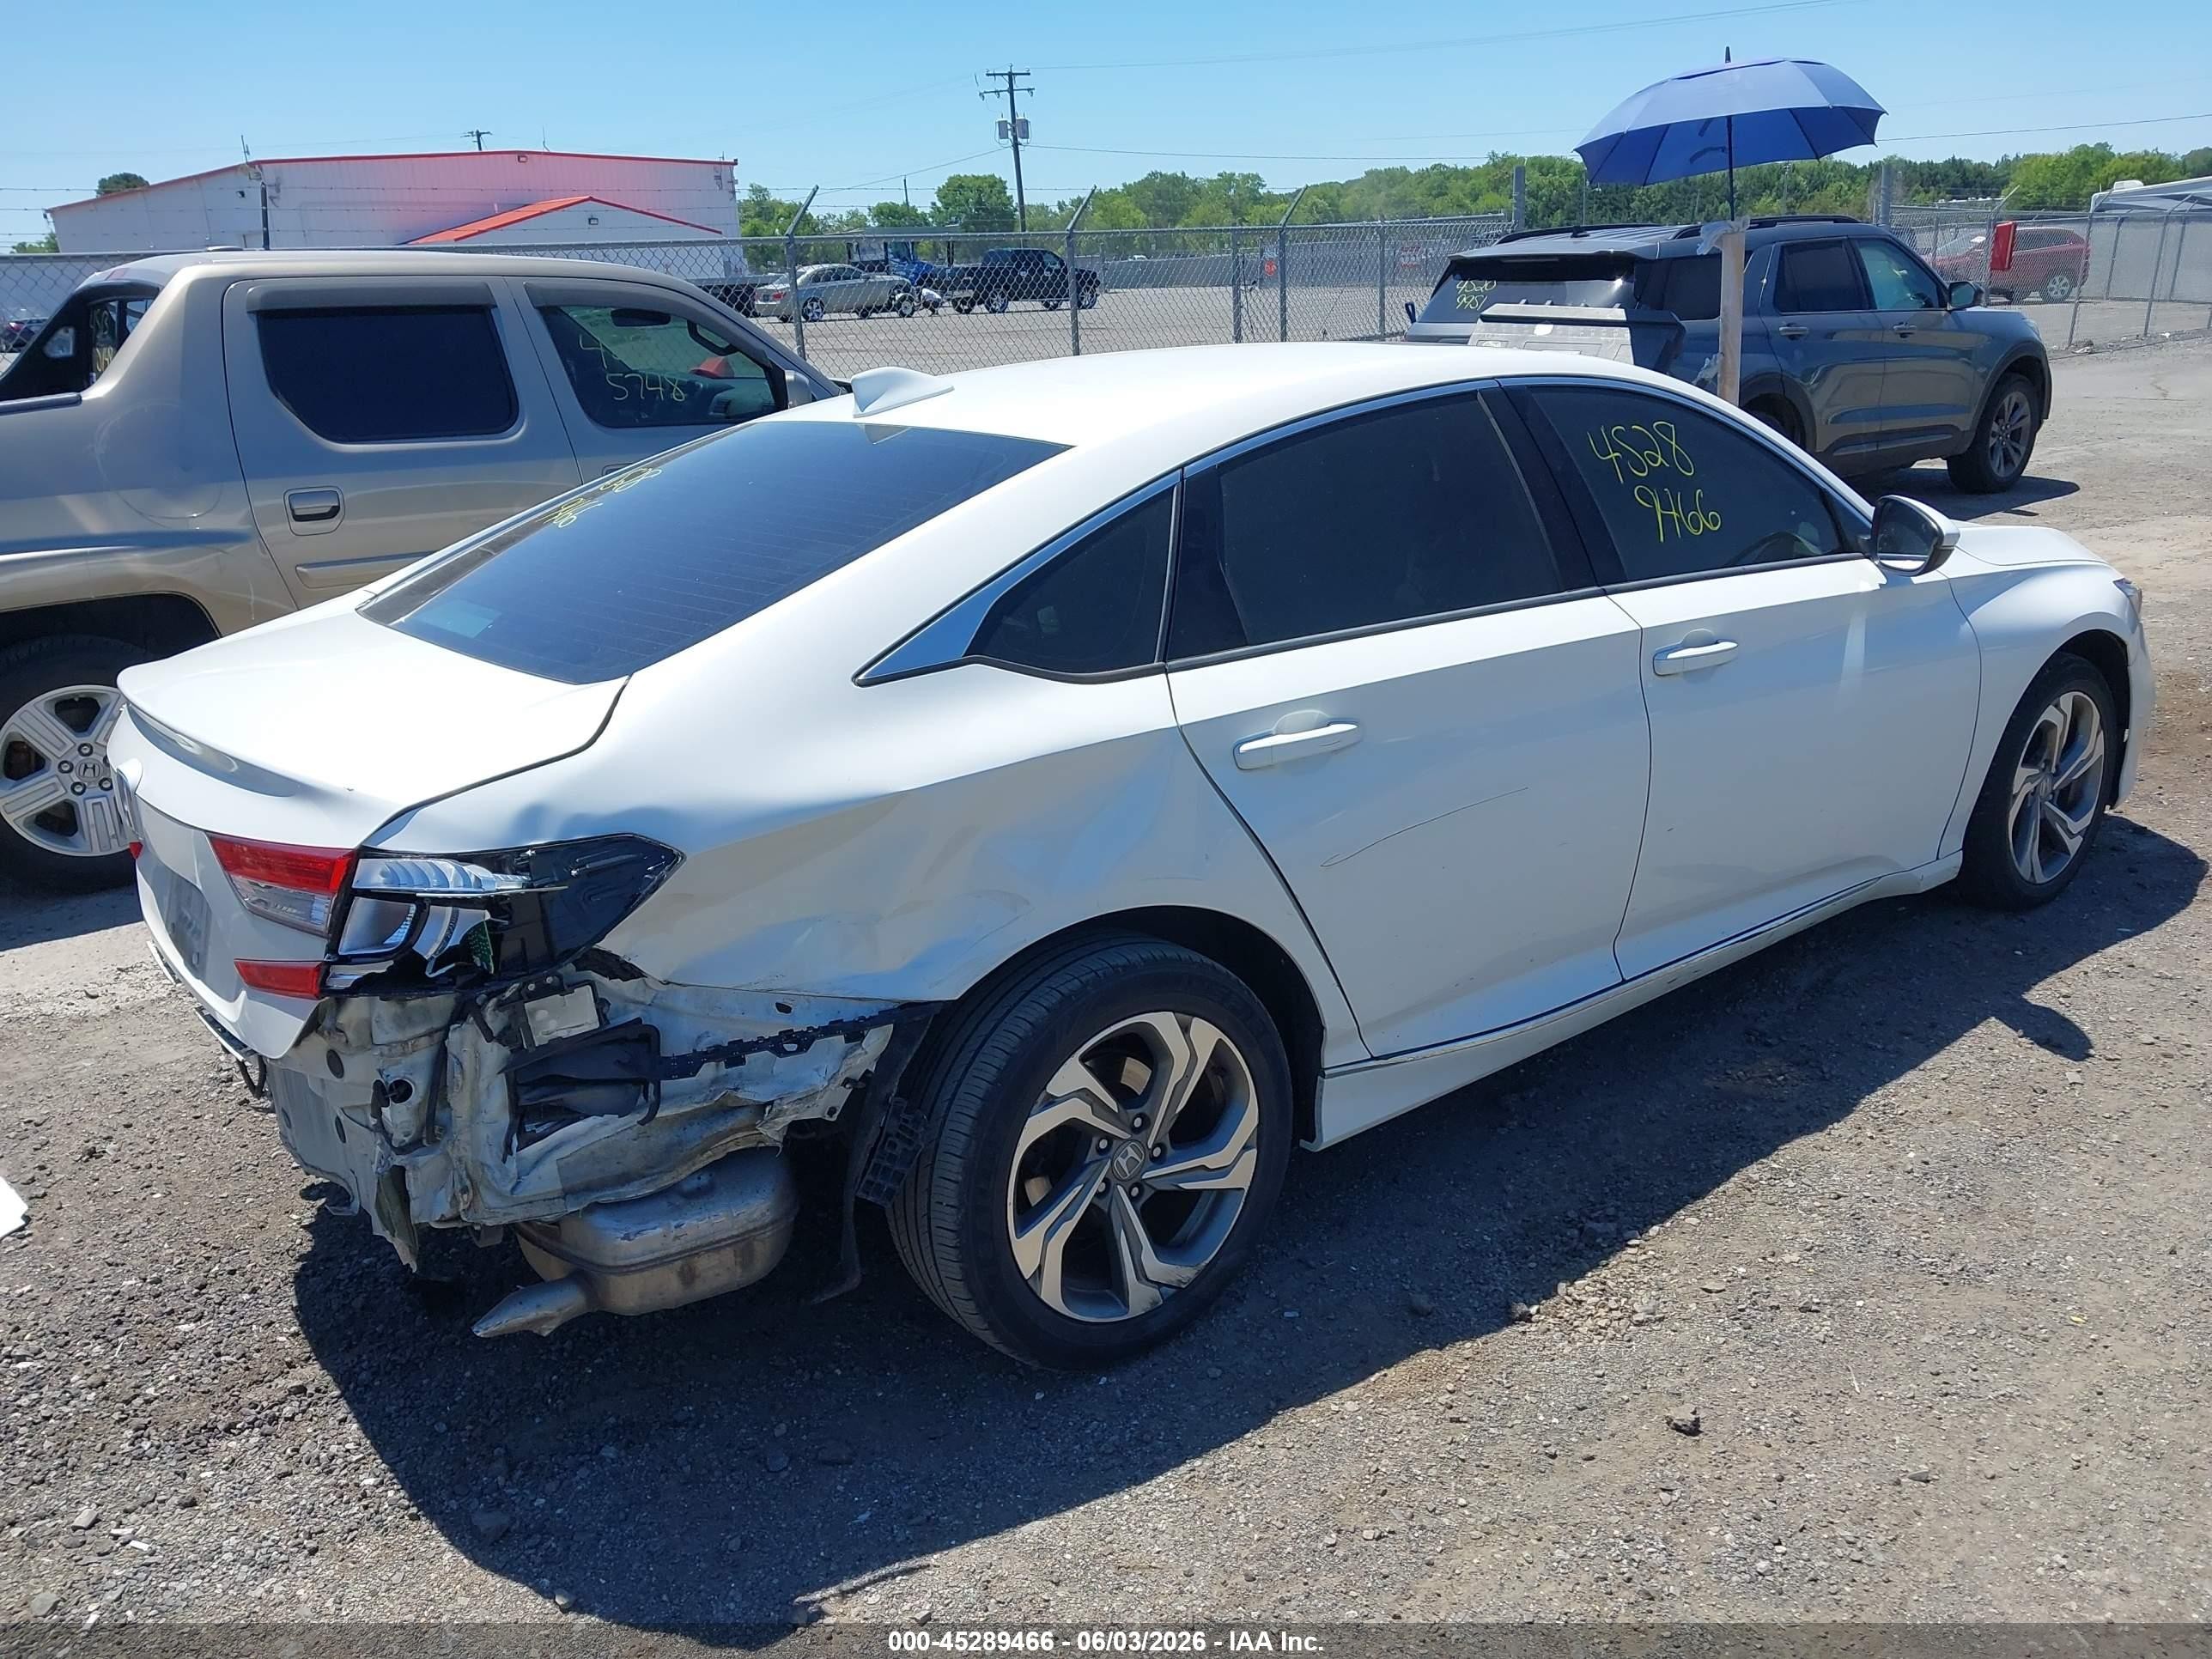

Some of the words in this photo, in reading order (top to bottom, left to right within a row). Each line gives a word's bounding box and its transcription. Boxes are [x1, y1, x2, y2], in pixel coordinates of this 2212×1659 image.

[1456, 294, 1488, 310] 9951
[605, 373, 685, 401] 5748
[1587, 421, 1694, 484] 4528
[1634, 485, 1722, 543] 9466
